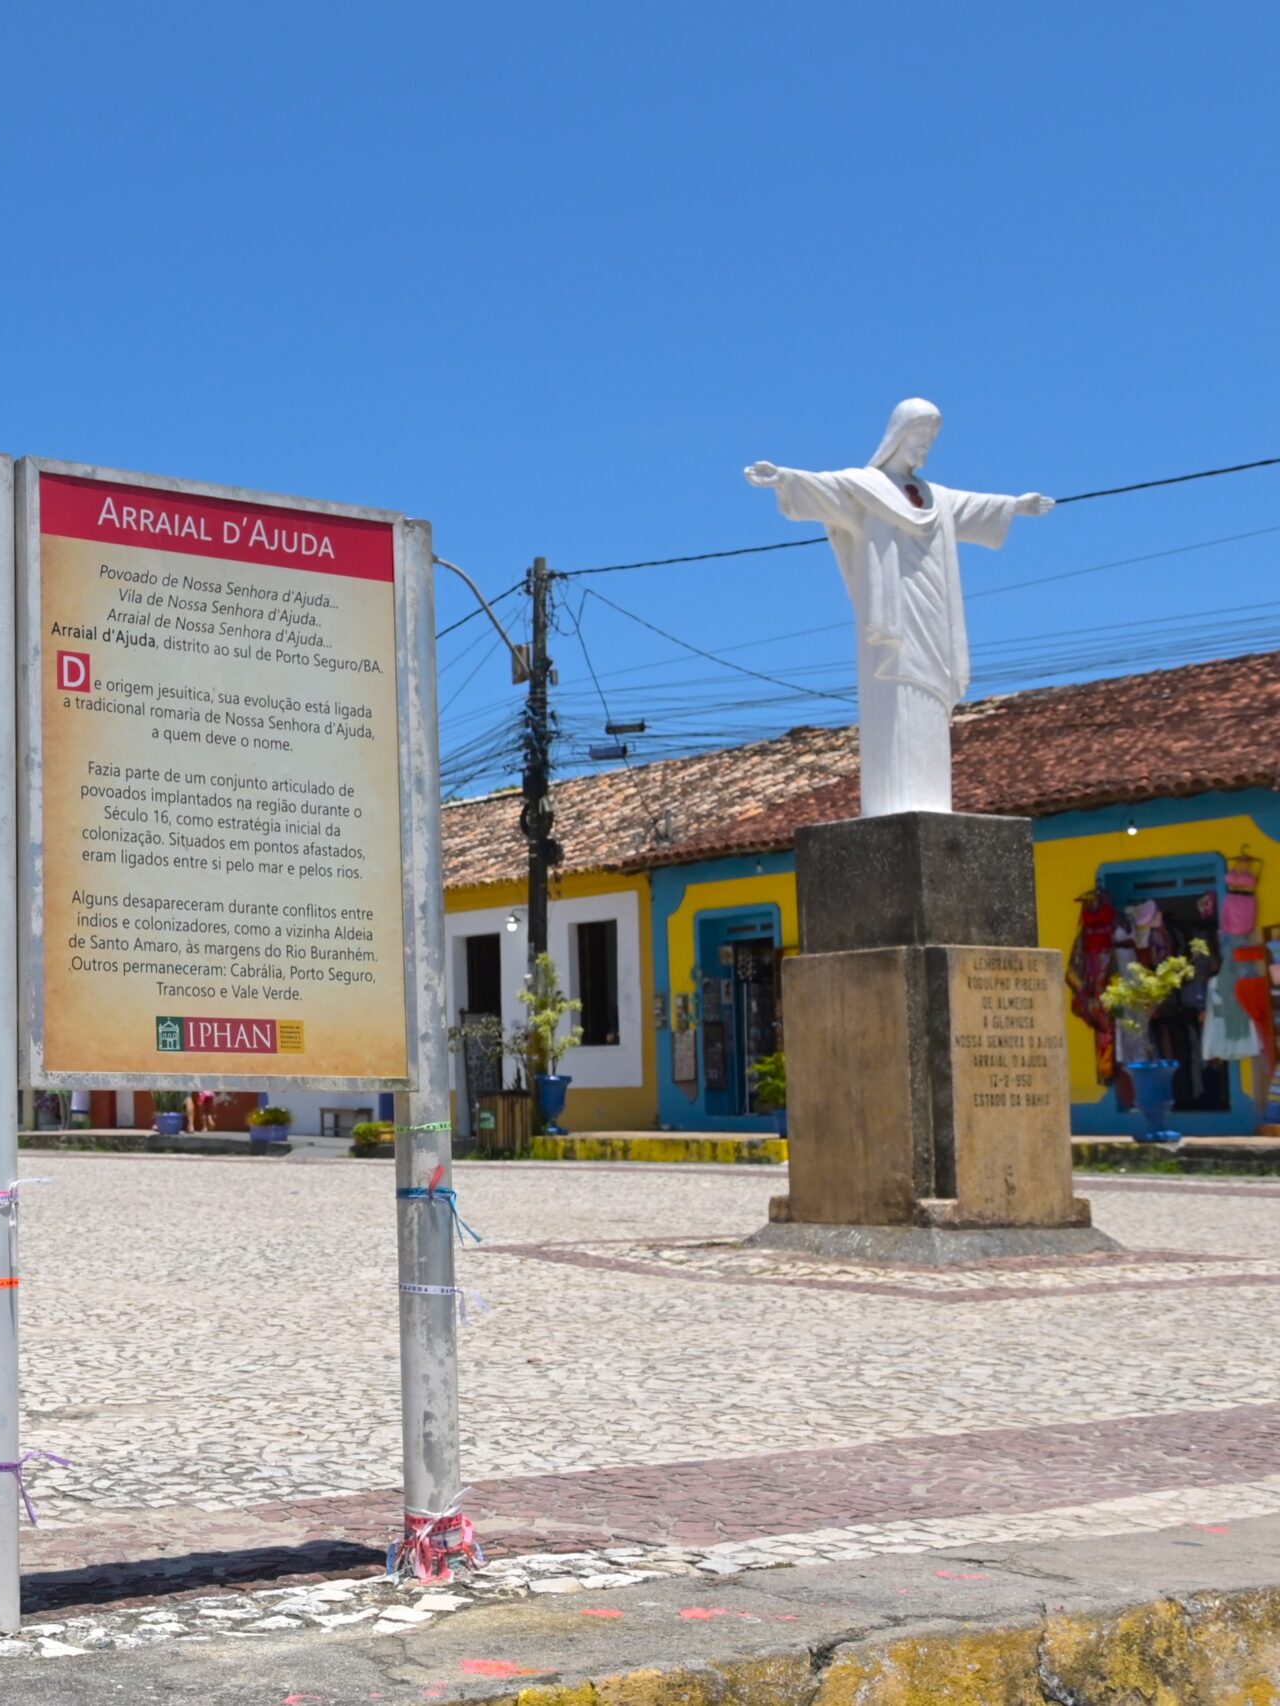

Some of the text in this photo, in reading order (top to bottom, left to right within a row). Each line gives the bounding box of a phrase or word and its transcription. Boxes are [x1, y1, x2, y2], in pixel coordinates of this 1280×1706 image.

[99, 564, 158, 585] Povoado
[162, 573, 179, 588] de
[182, 576, 222, 594] Nossa
[226, 581, 278, 601] Senhora
[119, 588, 143, 604] Vila
[146, 592, 164, 607] de
[167, 594, 207, 612] Nossa
[211, 600, 264, 619] Senhora
[106, 608, 151, 626] Arraial
[154, 614, 171, 629] de
[175, 616, 215, 634] Nossa
[218, 622, 272, 641] Senhora
[51, 621, 383, 674] Arraial d'Ajuda, distrito ao sul de Porto Seguro/BA.
[106, 678, 154, 698] origem
[156, 683, 215, 704] jesuítica,
[218, 693, 240, 705] sua
[244, 694, 301, 713] evolução
[305, 700, 330, 714] está
[334, 701, 372, 720] ligada
[63, 696, 375, 740] a tradicional romaria de Nossa Senhora d'Ajuda,
[151, 728, 293, 752] a quem deve o nome.
[88, 761, 355, 798] Fazia parte de um conjunto articulado de
[81, 785, 362, 818] povoados implantados na região durante o
[104, 805, 341, 837] Século 16, como estratégia inicial da
[82, 825, 366, 861] colonização. Situados em pontos afastados,
[82, 849, 362, 879] eram ligados entre si pelo mar e pelos rios.
[71, 890, 374, 921] Alguns desapareceram durante conflitos entre
[77, 911, 373, 941] índios e colonizadores, como a vizinha Aldeia
[68, 933, 378, 962] de Santo Amaro, às margens do Rio Buranhém.
[71, 956, 376, 986] Outros permaneceram: Cabrália, Porto Seguro,
[156, 981, 302, 1001] Trancoso e Vale Verde.
[982, 995, 1034, 1010] DE ALMEIDA
[188, 1021, 271, 1049] IPHAN
[983, 1015, 1035, 1029] A GLORIOSA
[955, 1034, 982, 1049] NOSSA
[987, 1034, 1024, 1049] SENHORA
[974, 1054, 1007, 1068] ARRAIAL
[974, 1092, 1050, 1107] ESTADO DA BAHIA
